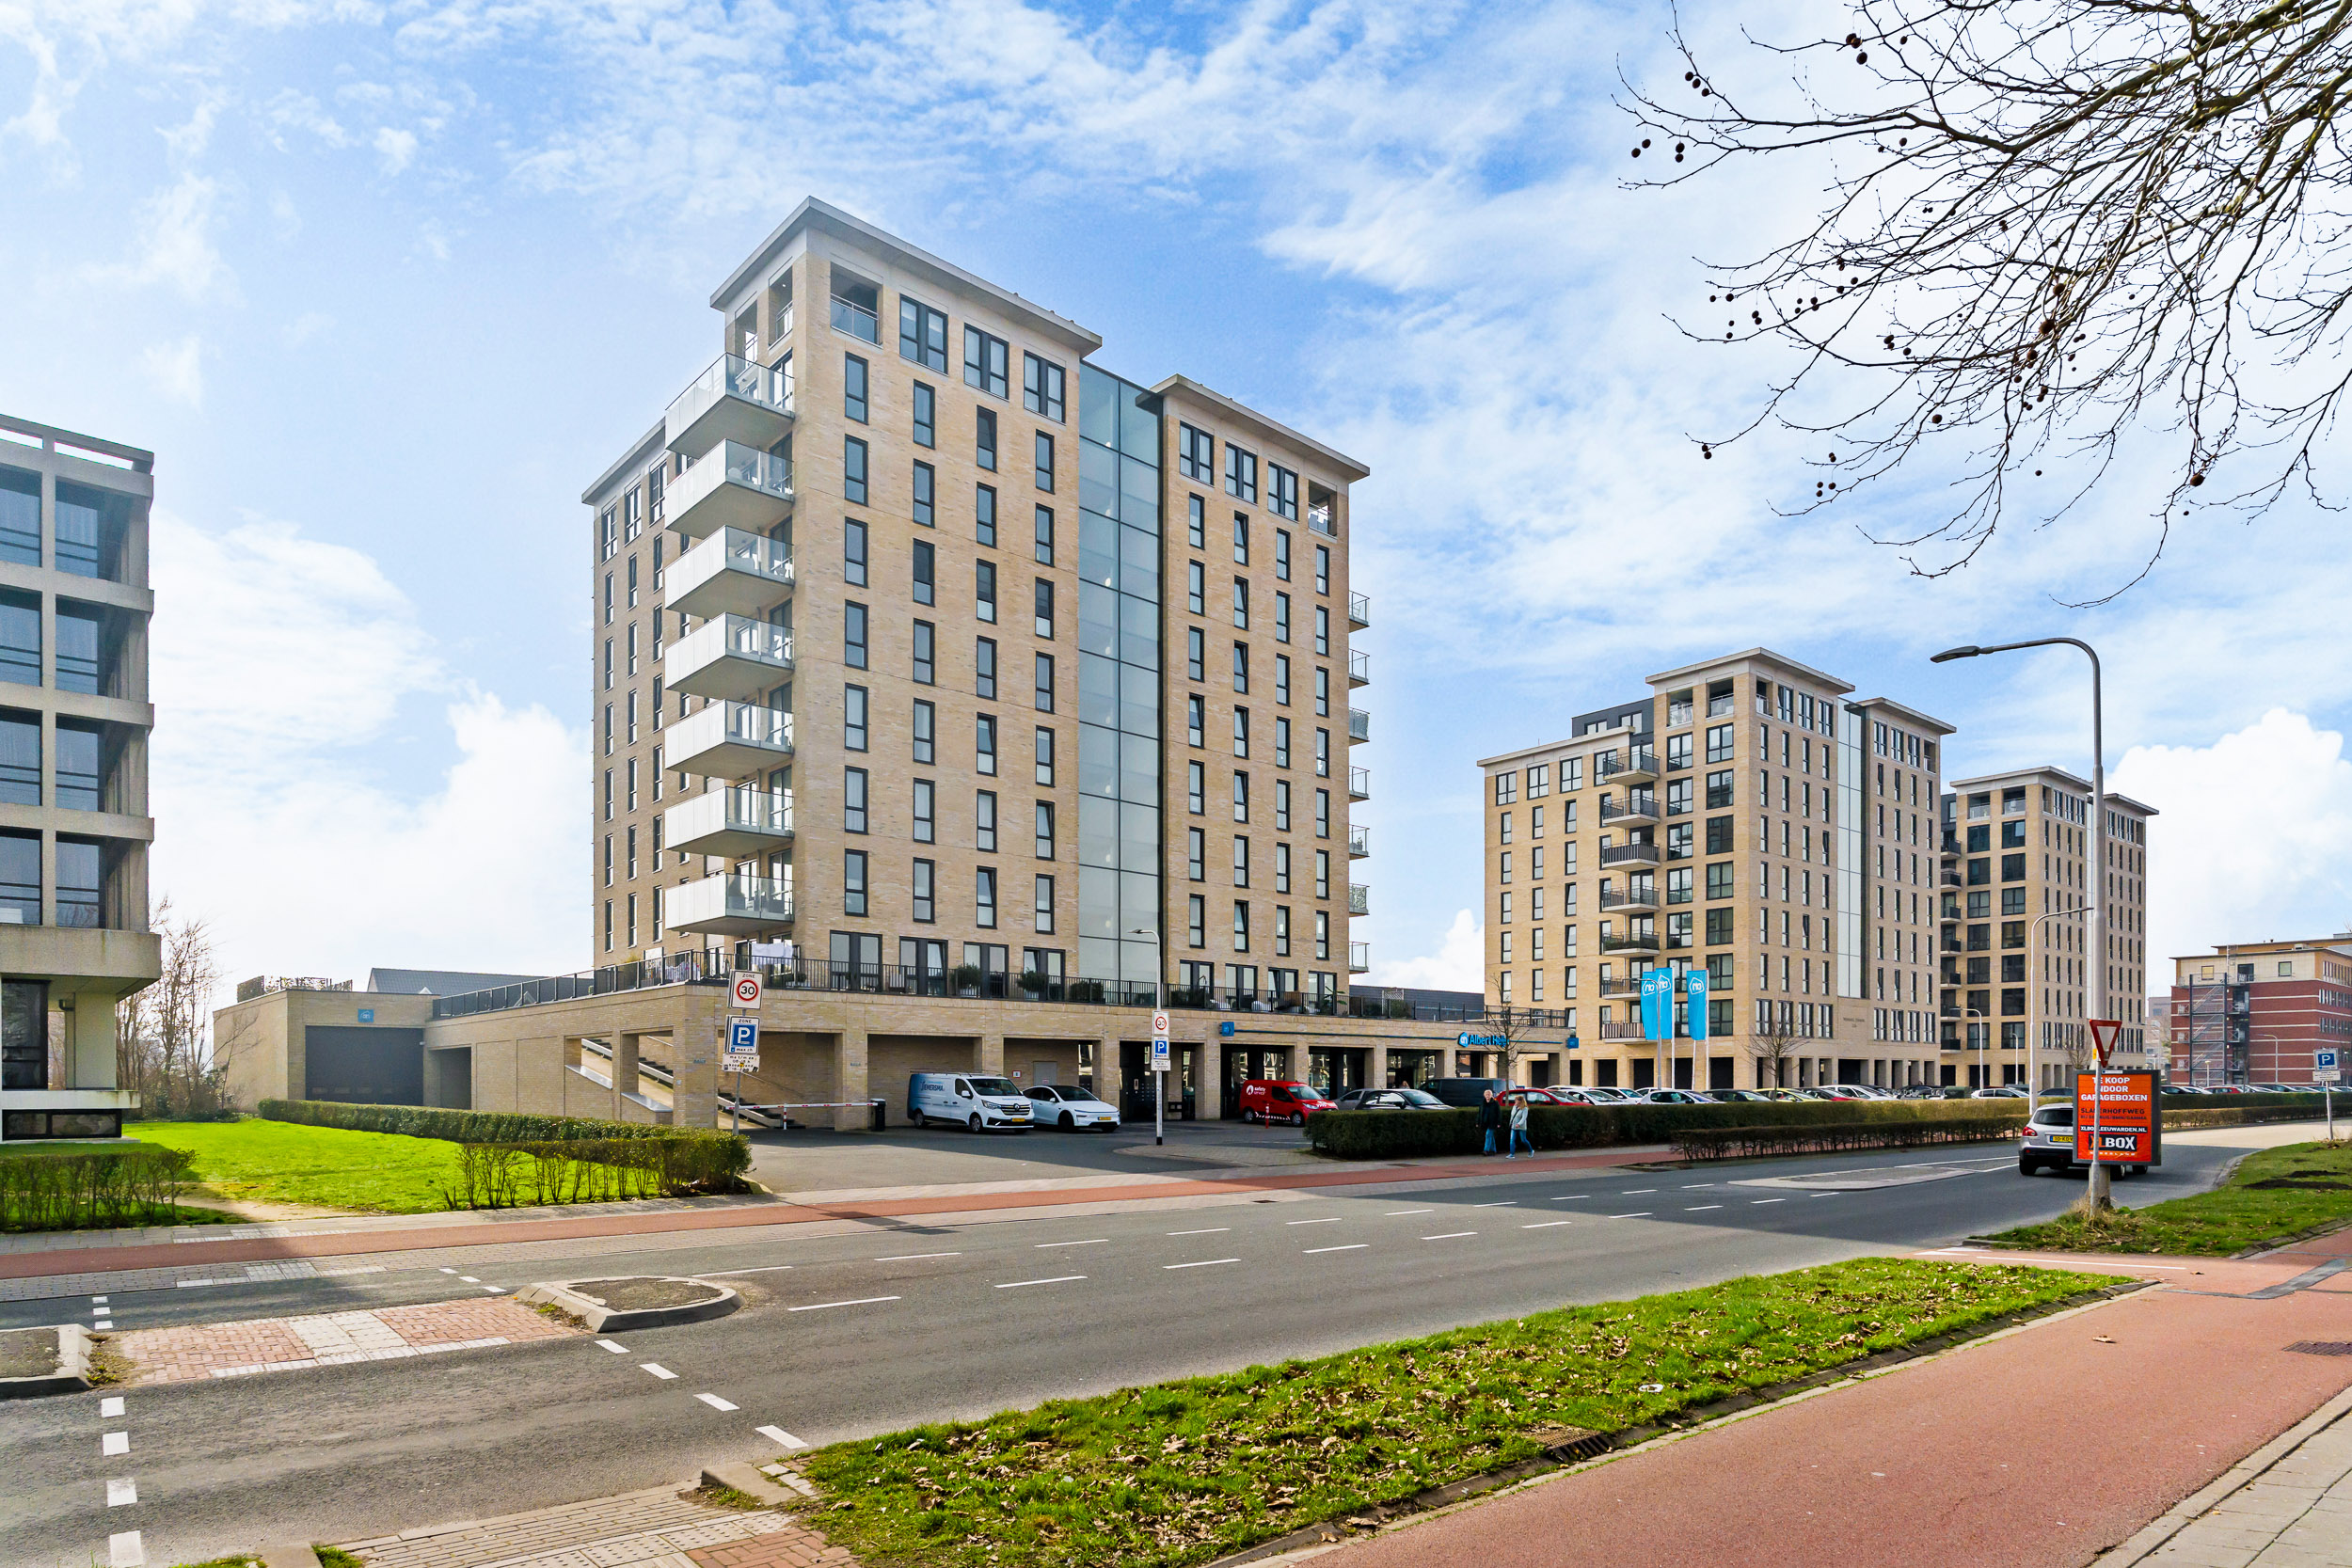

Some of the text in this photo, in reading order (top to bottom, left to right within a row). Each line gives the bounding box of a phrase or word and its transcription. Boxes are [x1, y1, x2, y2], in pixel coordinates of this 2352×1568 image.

[740, 986, 755, 995] 30
[738, 1027, 750, 1044] P
[1469, 1035, 1491, 1045] Albert
[1157, 1042, 1165, 1053] P
[2322, 1054, 2331, 1065] P
